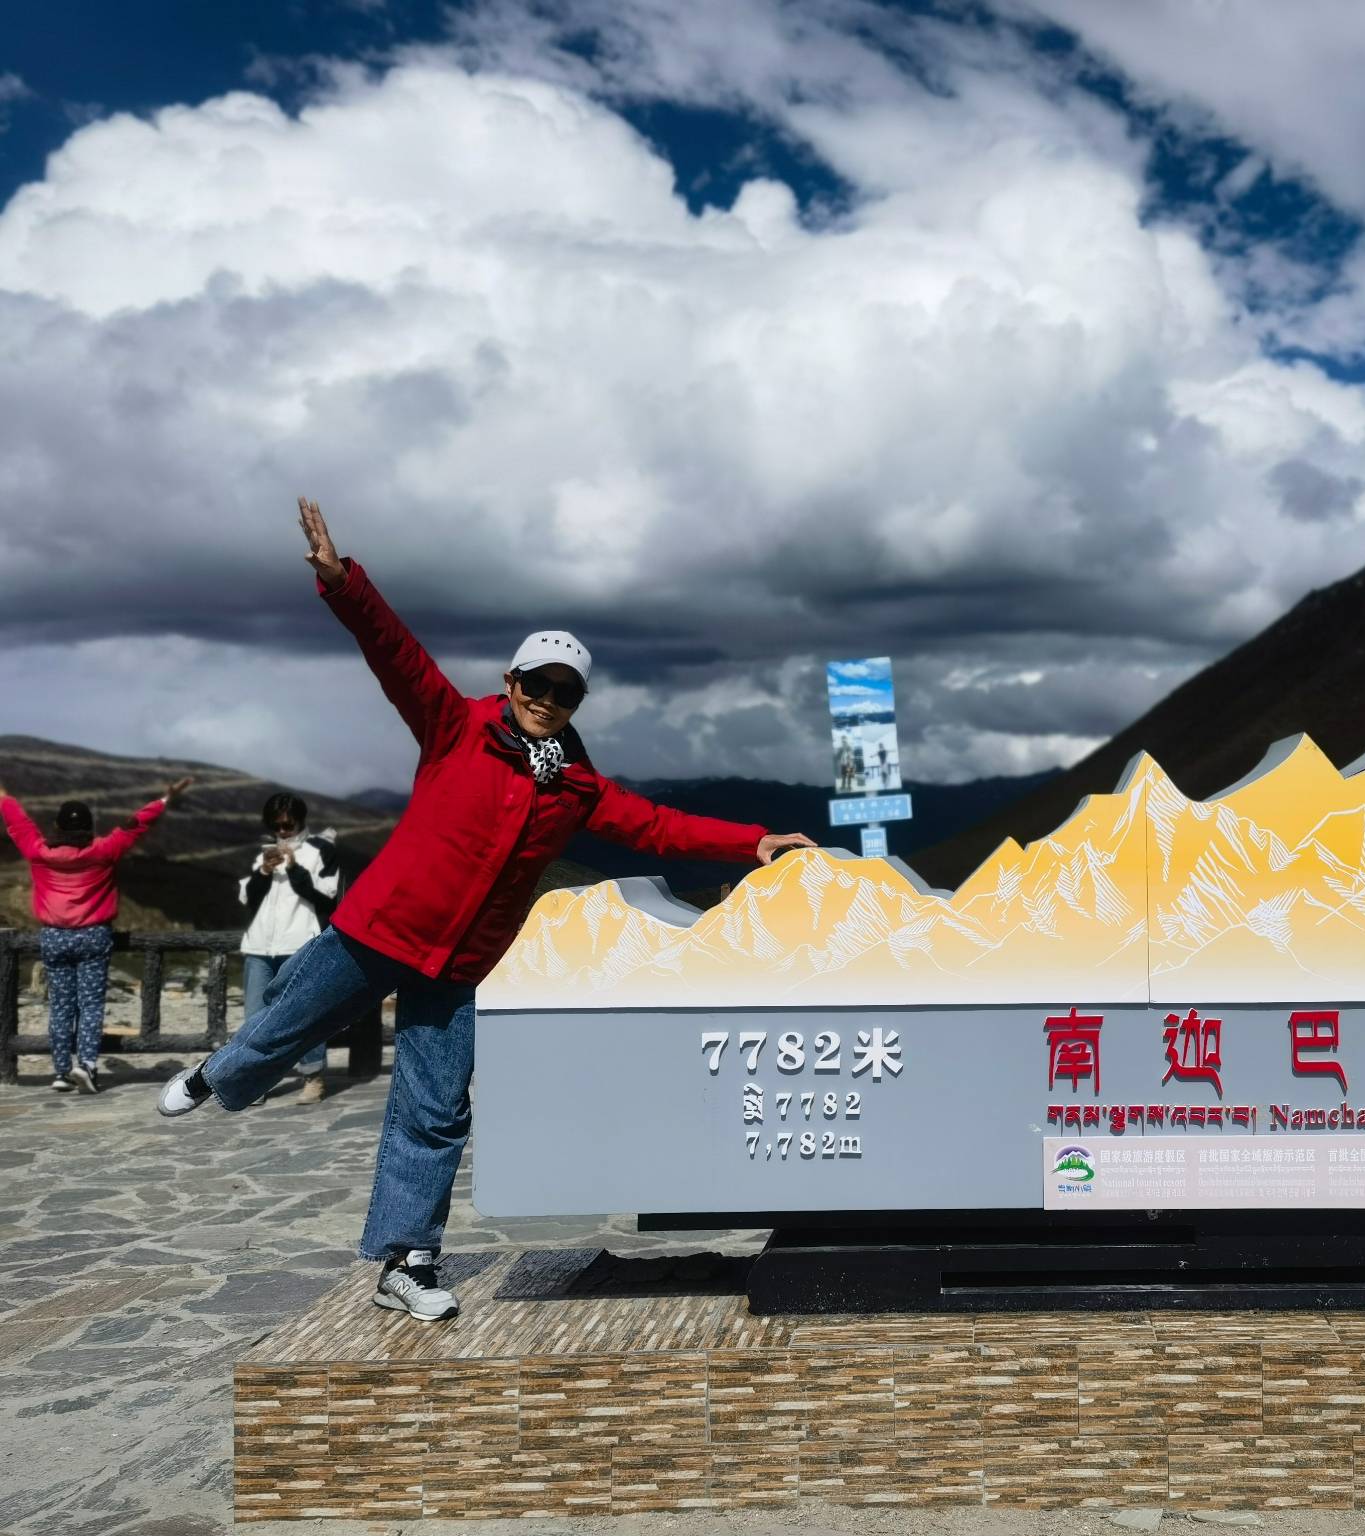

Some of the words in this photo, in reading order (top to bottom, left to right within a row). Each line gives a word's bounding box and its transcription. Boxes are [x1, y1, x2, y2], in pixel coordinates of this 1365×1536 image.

[701, 1027, 904, 1082] 7782米
[775, 1091, 862, 1120] 7782
[745, 1131, 863, 1160] 7,782m
[1100, 1148, 1187, 1164] 国家级旅游度假区
